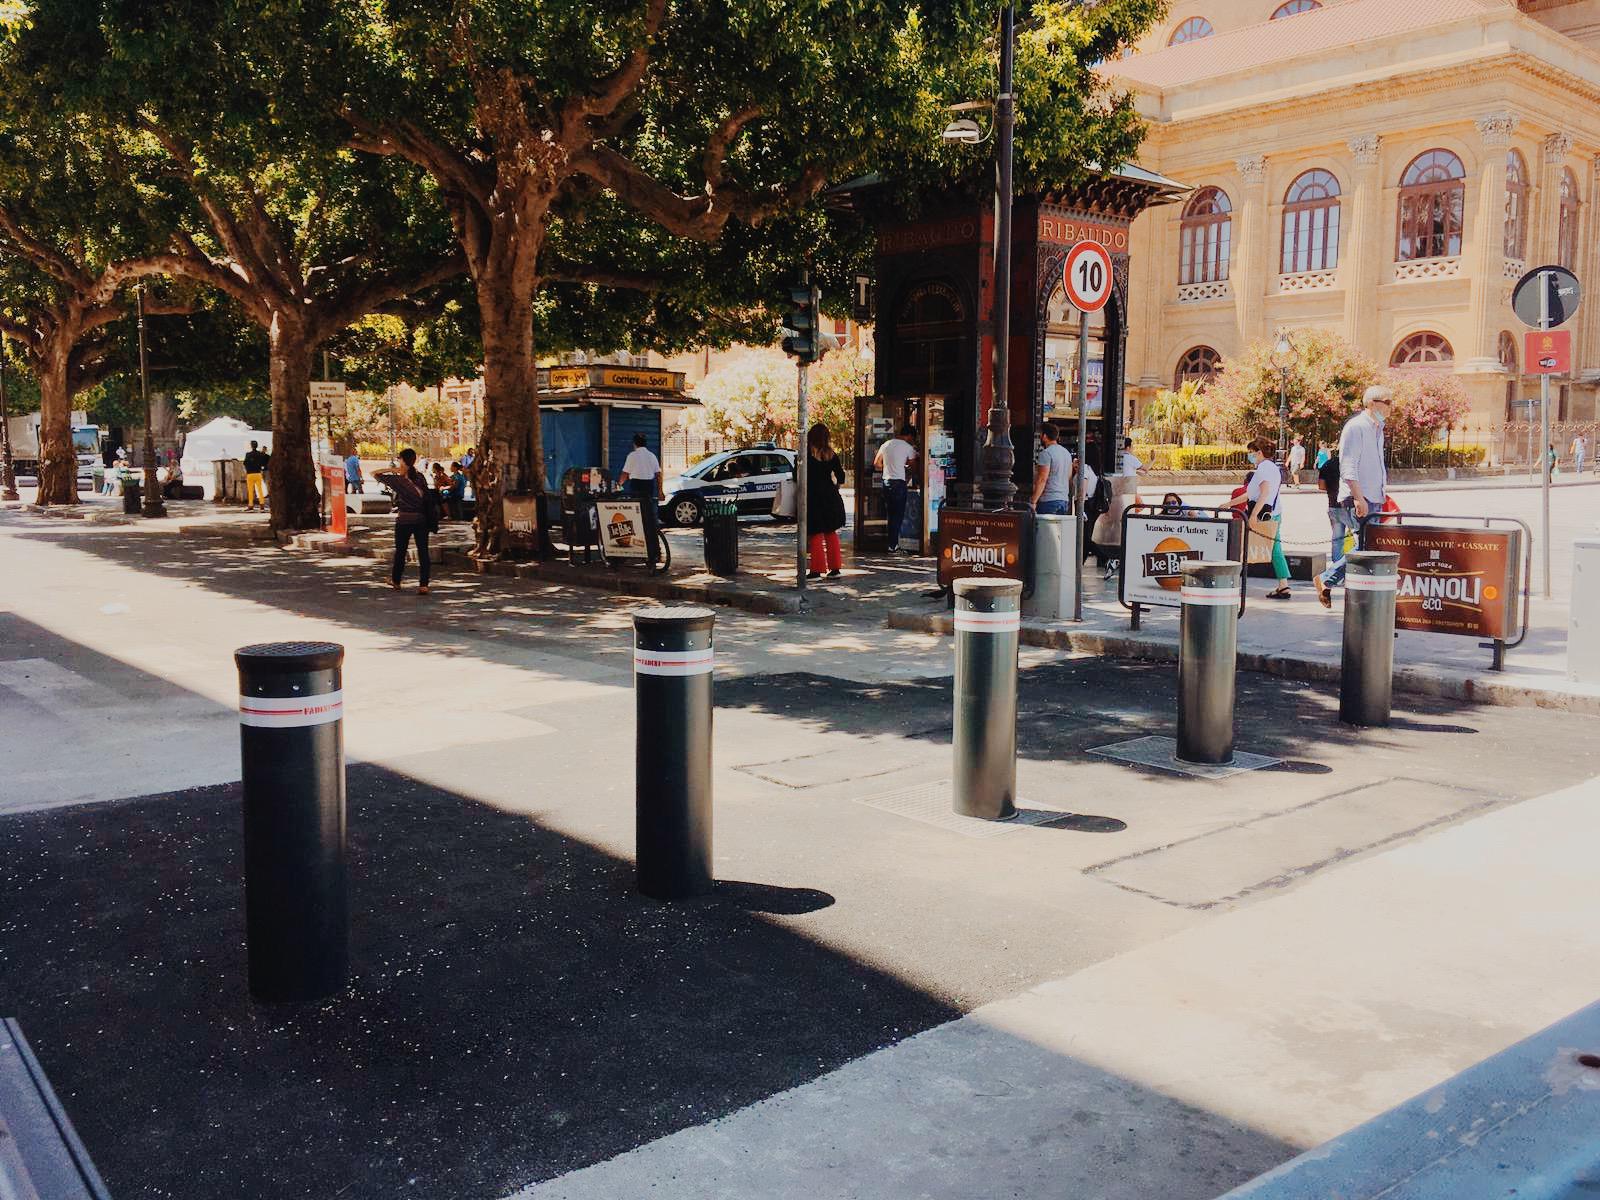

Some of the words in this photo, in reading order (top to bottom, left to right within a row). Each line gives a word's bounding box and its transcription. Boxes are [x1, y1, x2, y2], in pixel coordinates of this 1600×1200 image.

[1043, 219, 1126, 248] RIBAUDO
[1079, 260, 1102, 292] 10
[612, 374, 640, 385] Corriere
[649, 376, 668, 386] Sport
[1376, 537, 1411, 546] CANNOLI
[1418, 540, 1455, 549] GRANITE
[1462, 542, 1500, 551] CASSATE
[952, 543, 1006, 568] CANNOLI
[1422, 598, 1443, 611] &CO.
